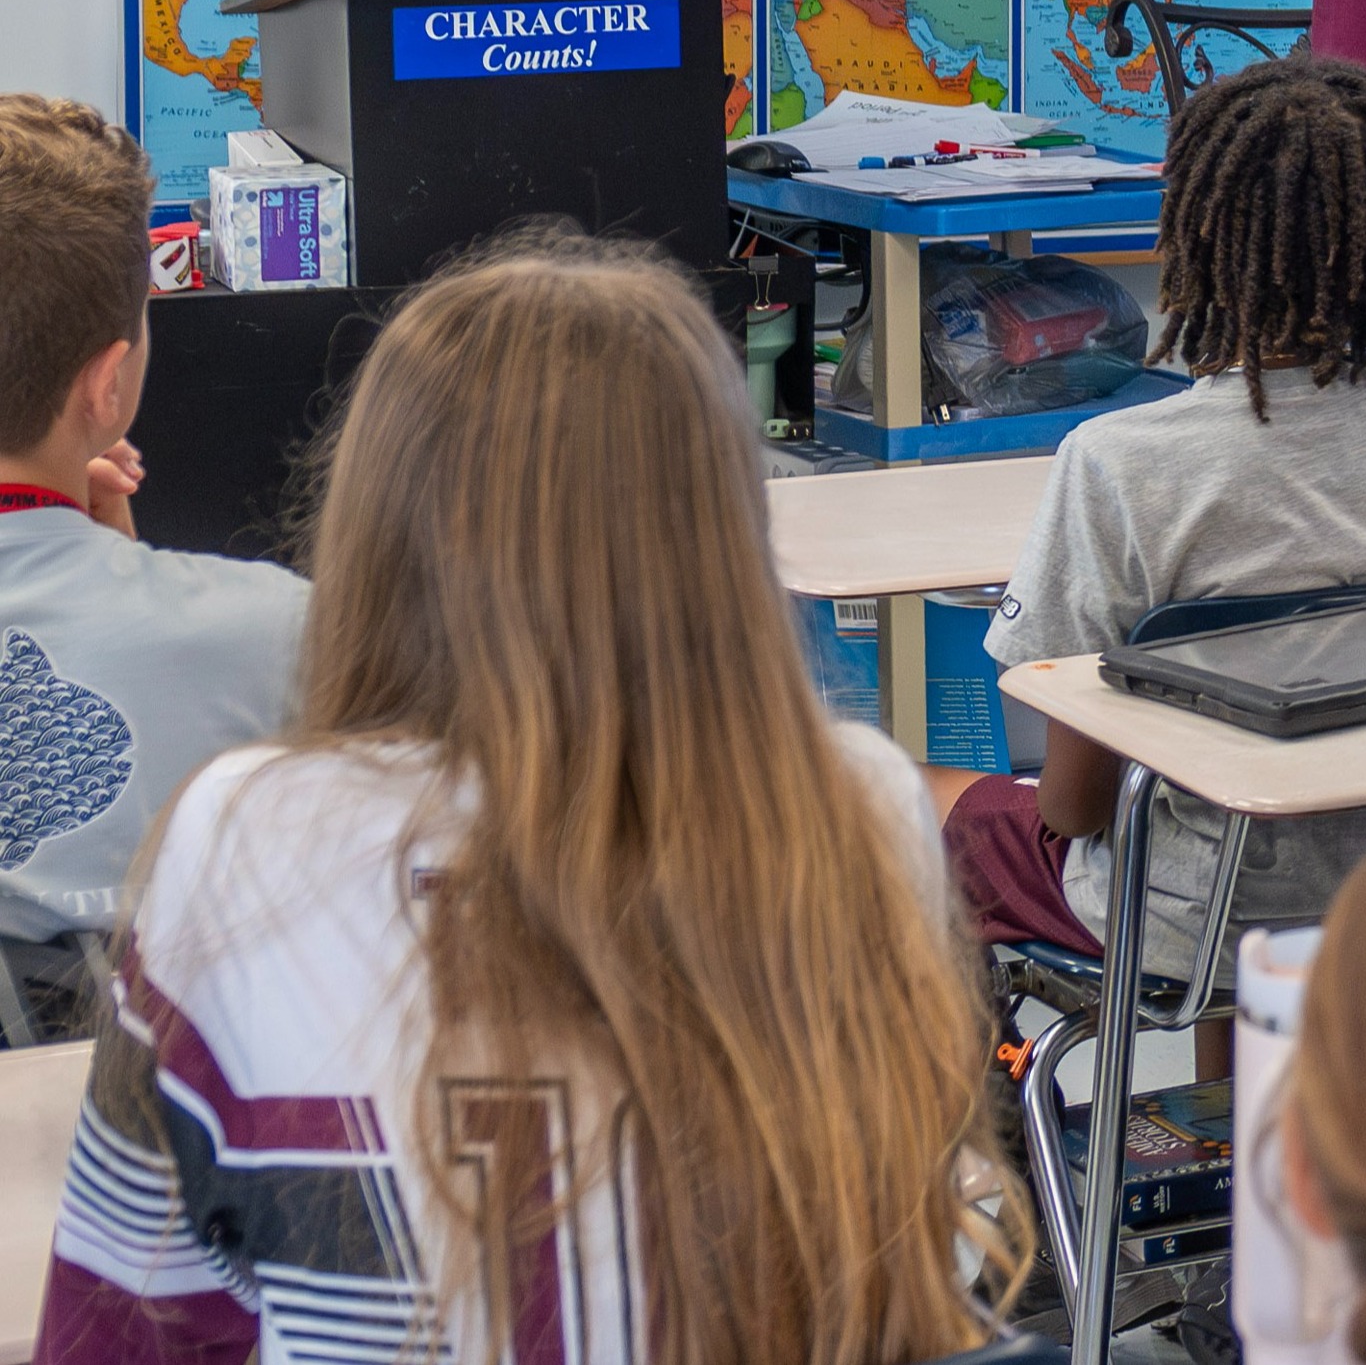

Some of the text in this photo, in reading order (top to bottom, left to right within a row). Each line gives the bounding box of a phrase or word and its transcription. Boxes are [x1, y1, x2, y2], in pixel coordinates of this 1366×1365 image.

[424, 3, 650, 43] CHARACTER
[481, 40, 598, 72] Counts!
[298, 189, 317, 279] Ultra Soft
